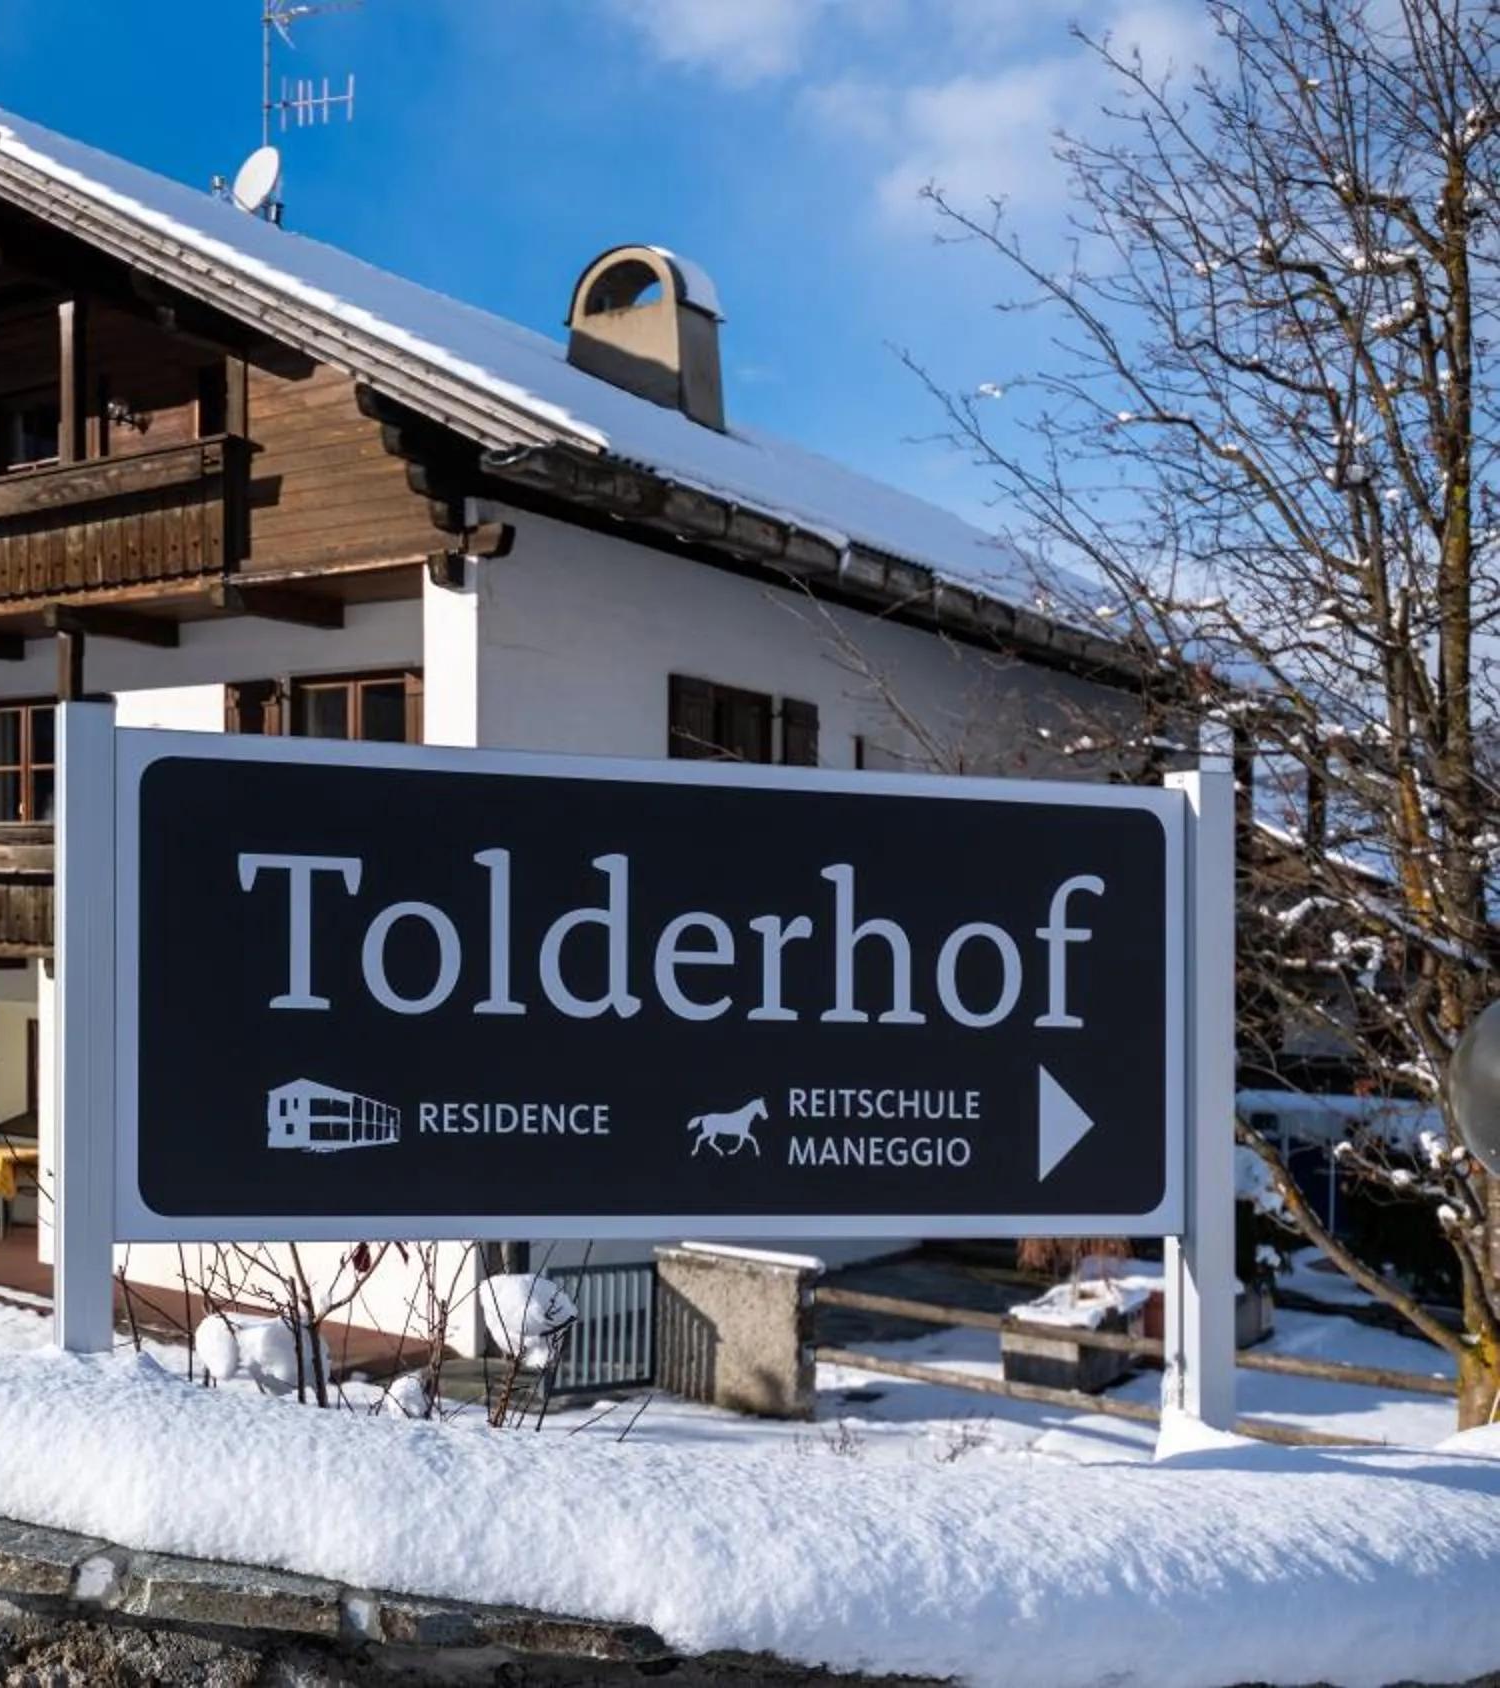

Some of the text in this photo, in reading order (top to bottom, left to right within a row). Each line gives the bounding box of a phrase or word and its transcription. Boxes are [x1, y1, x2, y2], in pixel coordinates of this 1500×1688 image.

[237, 848, 1105, 1028] Tolderhof
[418, 1102, 610, 1135] RESIDENCE
[788, 1087, 981, 1120] REITSCHULE
[787, 1136, 971, 1167] MANEGGIO
